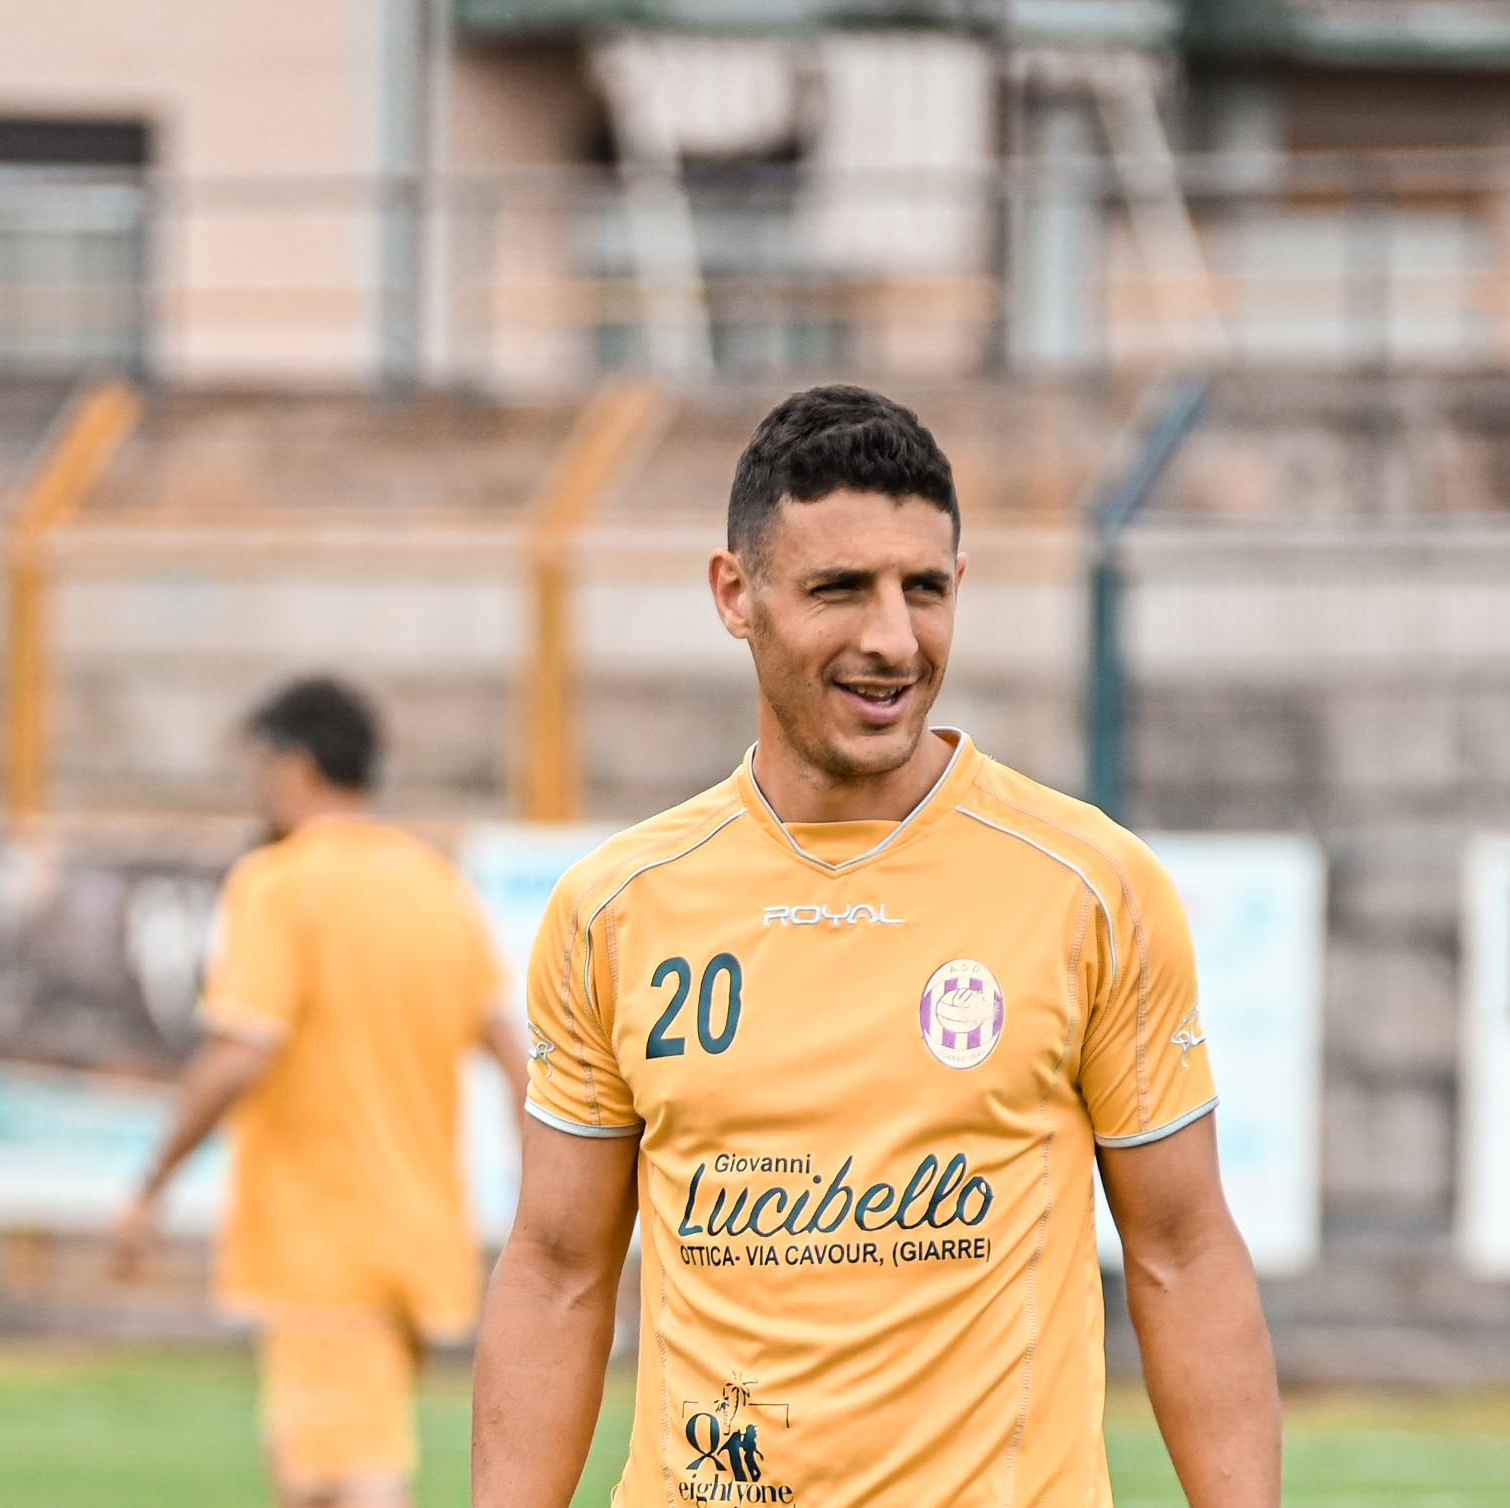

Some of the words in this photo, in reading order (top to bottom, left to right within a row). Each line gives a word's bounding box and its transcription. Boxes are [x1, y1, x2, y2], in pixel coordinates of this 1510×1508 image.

[762, 903, 907, 927] ROYAL
[645, 952, 743, 1060] 20
[714, 1153, 811, 1174] Giovanni
[678, 1153, 994, 1237] Lucibello
[745, 1245, 780, 1266] VIA
[785, 1242, 884, 1266] CAVOUR,
[892, 1237, 991, 1268] (GIARRE)
